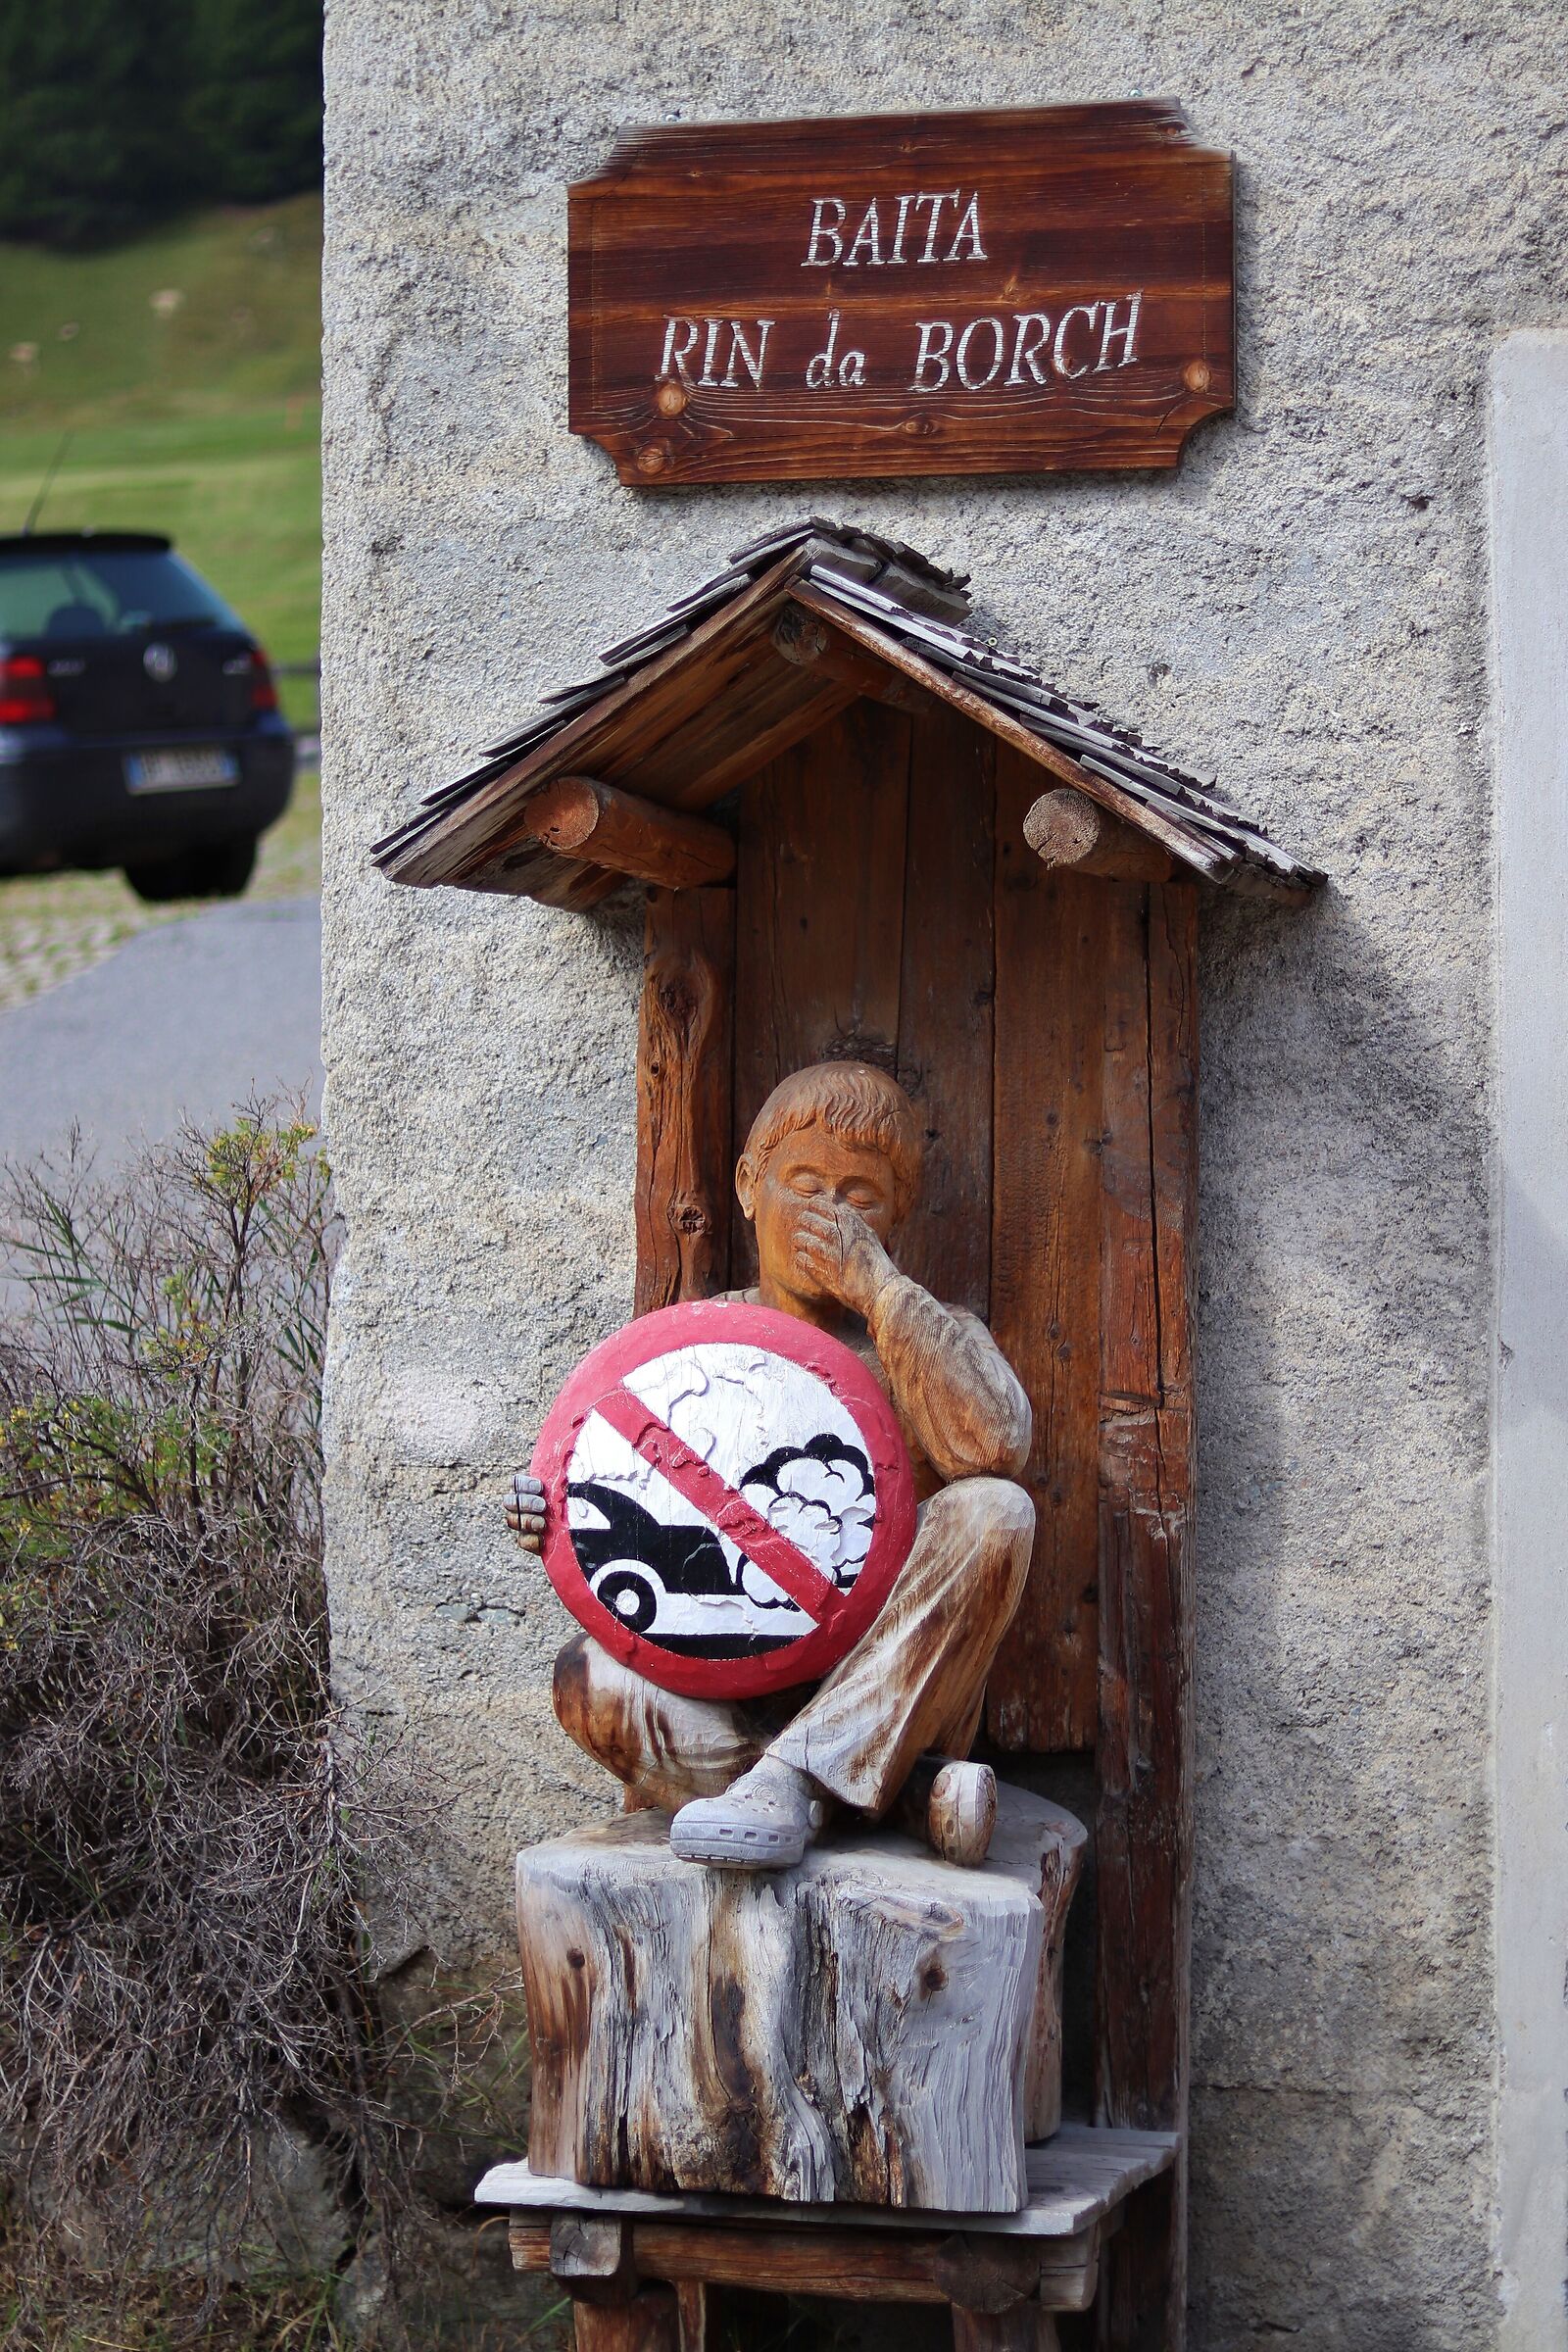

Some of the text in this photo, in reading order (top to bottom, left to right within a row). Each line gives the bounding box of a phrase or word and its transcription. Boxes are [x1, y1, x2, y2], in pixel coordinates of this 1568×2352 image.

[801, 189, 988, 267] BAITA
[655, 290, 1143, 392] RIN da BORCH
